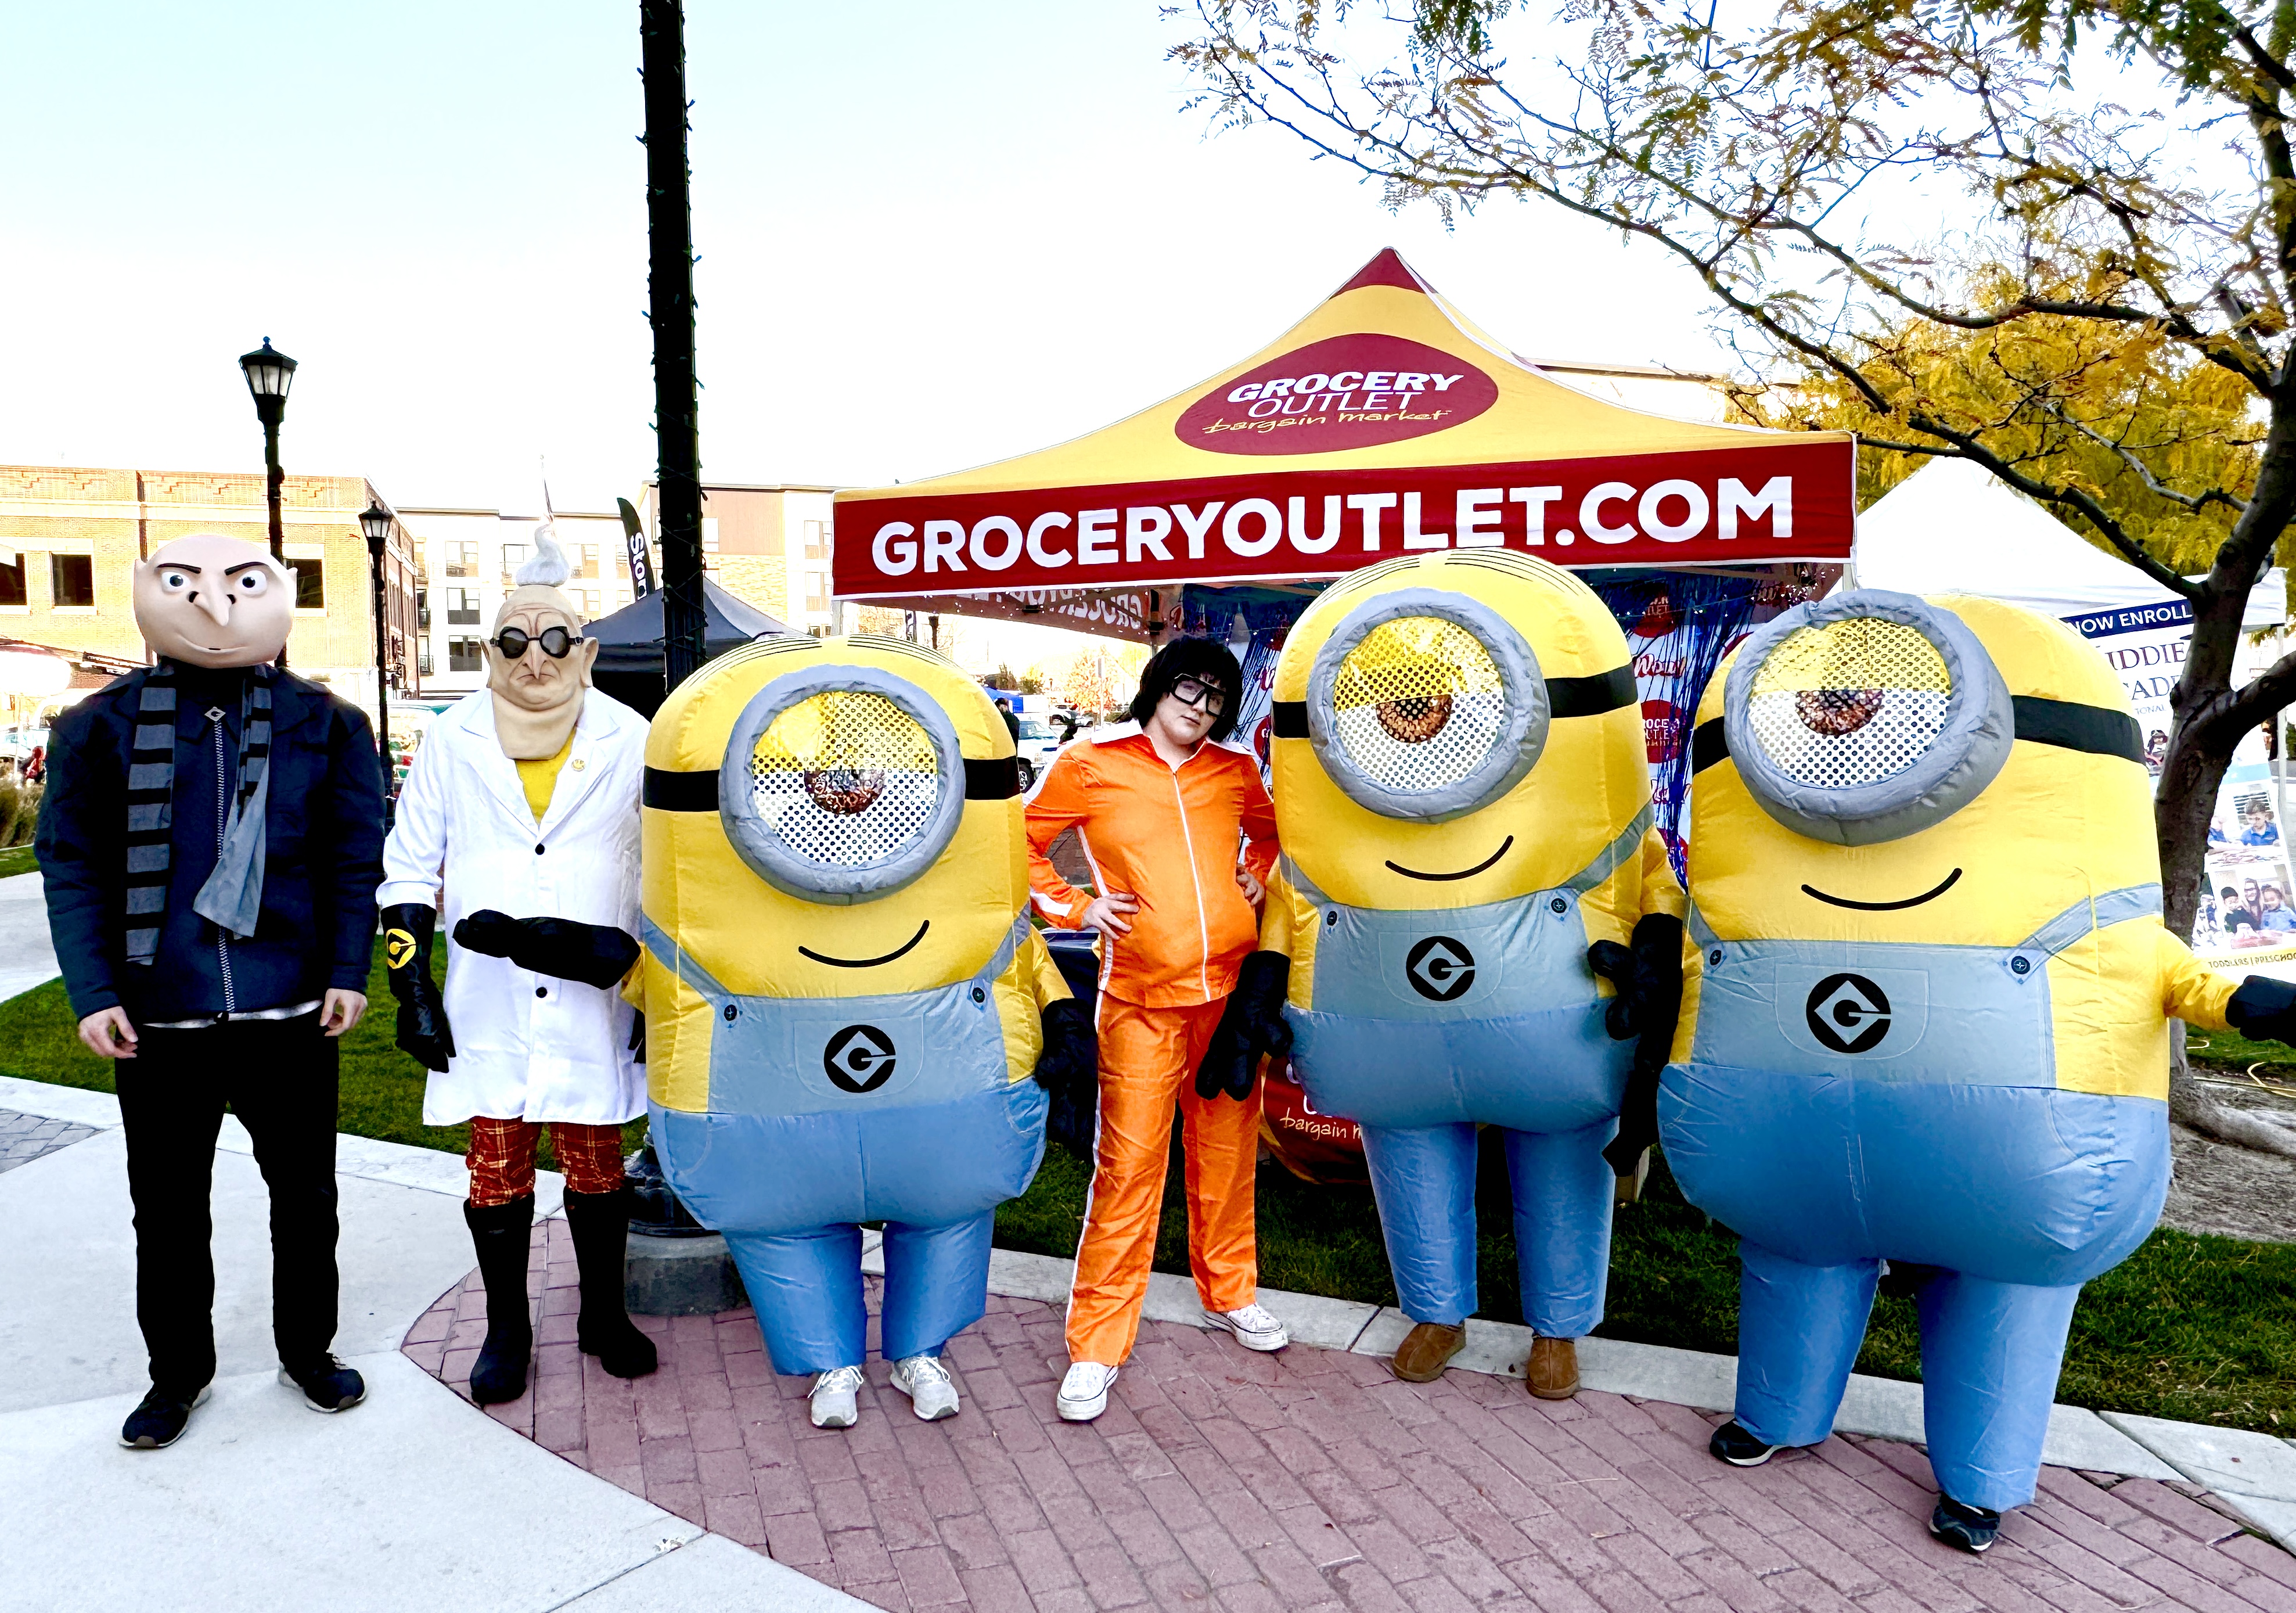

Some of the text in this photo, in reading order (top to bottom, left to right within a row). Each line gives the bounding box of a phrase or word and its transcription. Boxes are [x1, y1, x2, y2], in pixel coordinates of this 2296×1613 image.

[1227, 371, 1464, 403] GROCERY
[1248, 391, 1422, 418] OUTLET
[1202, 409, 1452, 434] bargain market
[872, 476, 1793, 576] GROCERYOUTLET.COM
[2119, 605, 2193, 627] ENROLL
[1279, 1107, 1347, 1141] bargain
